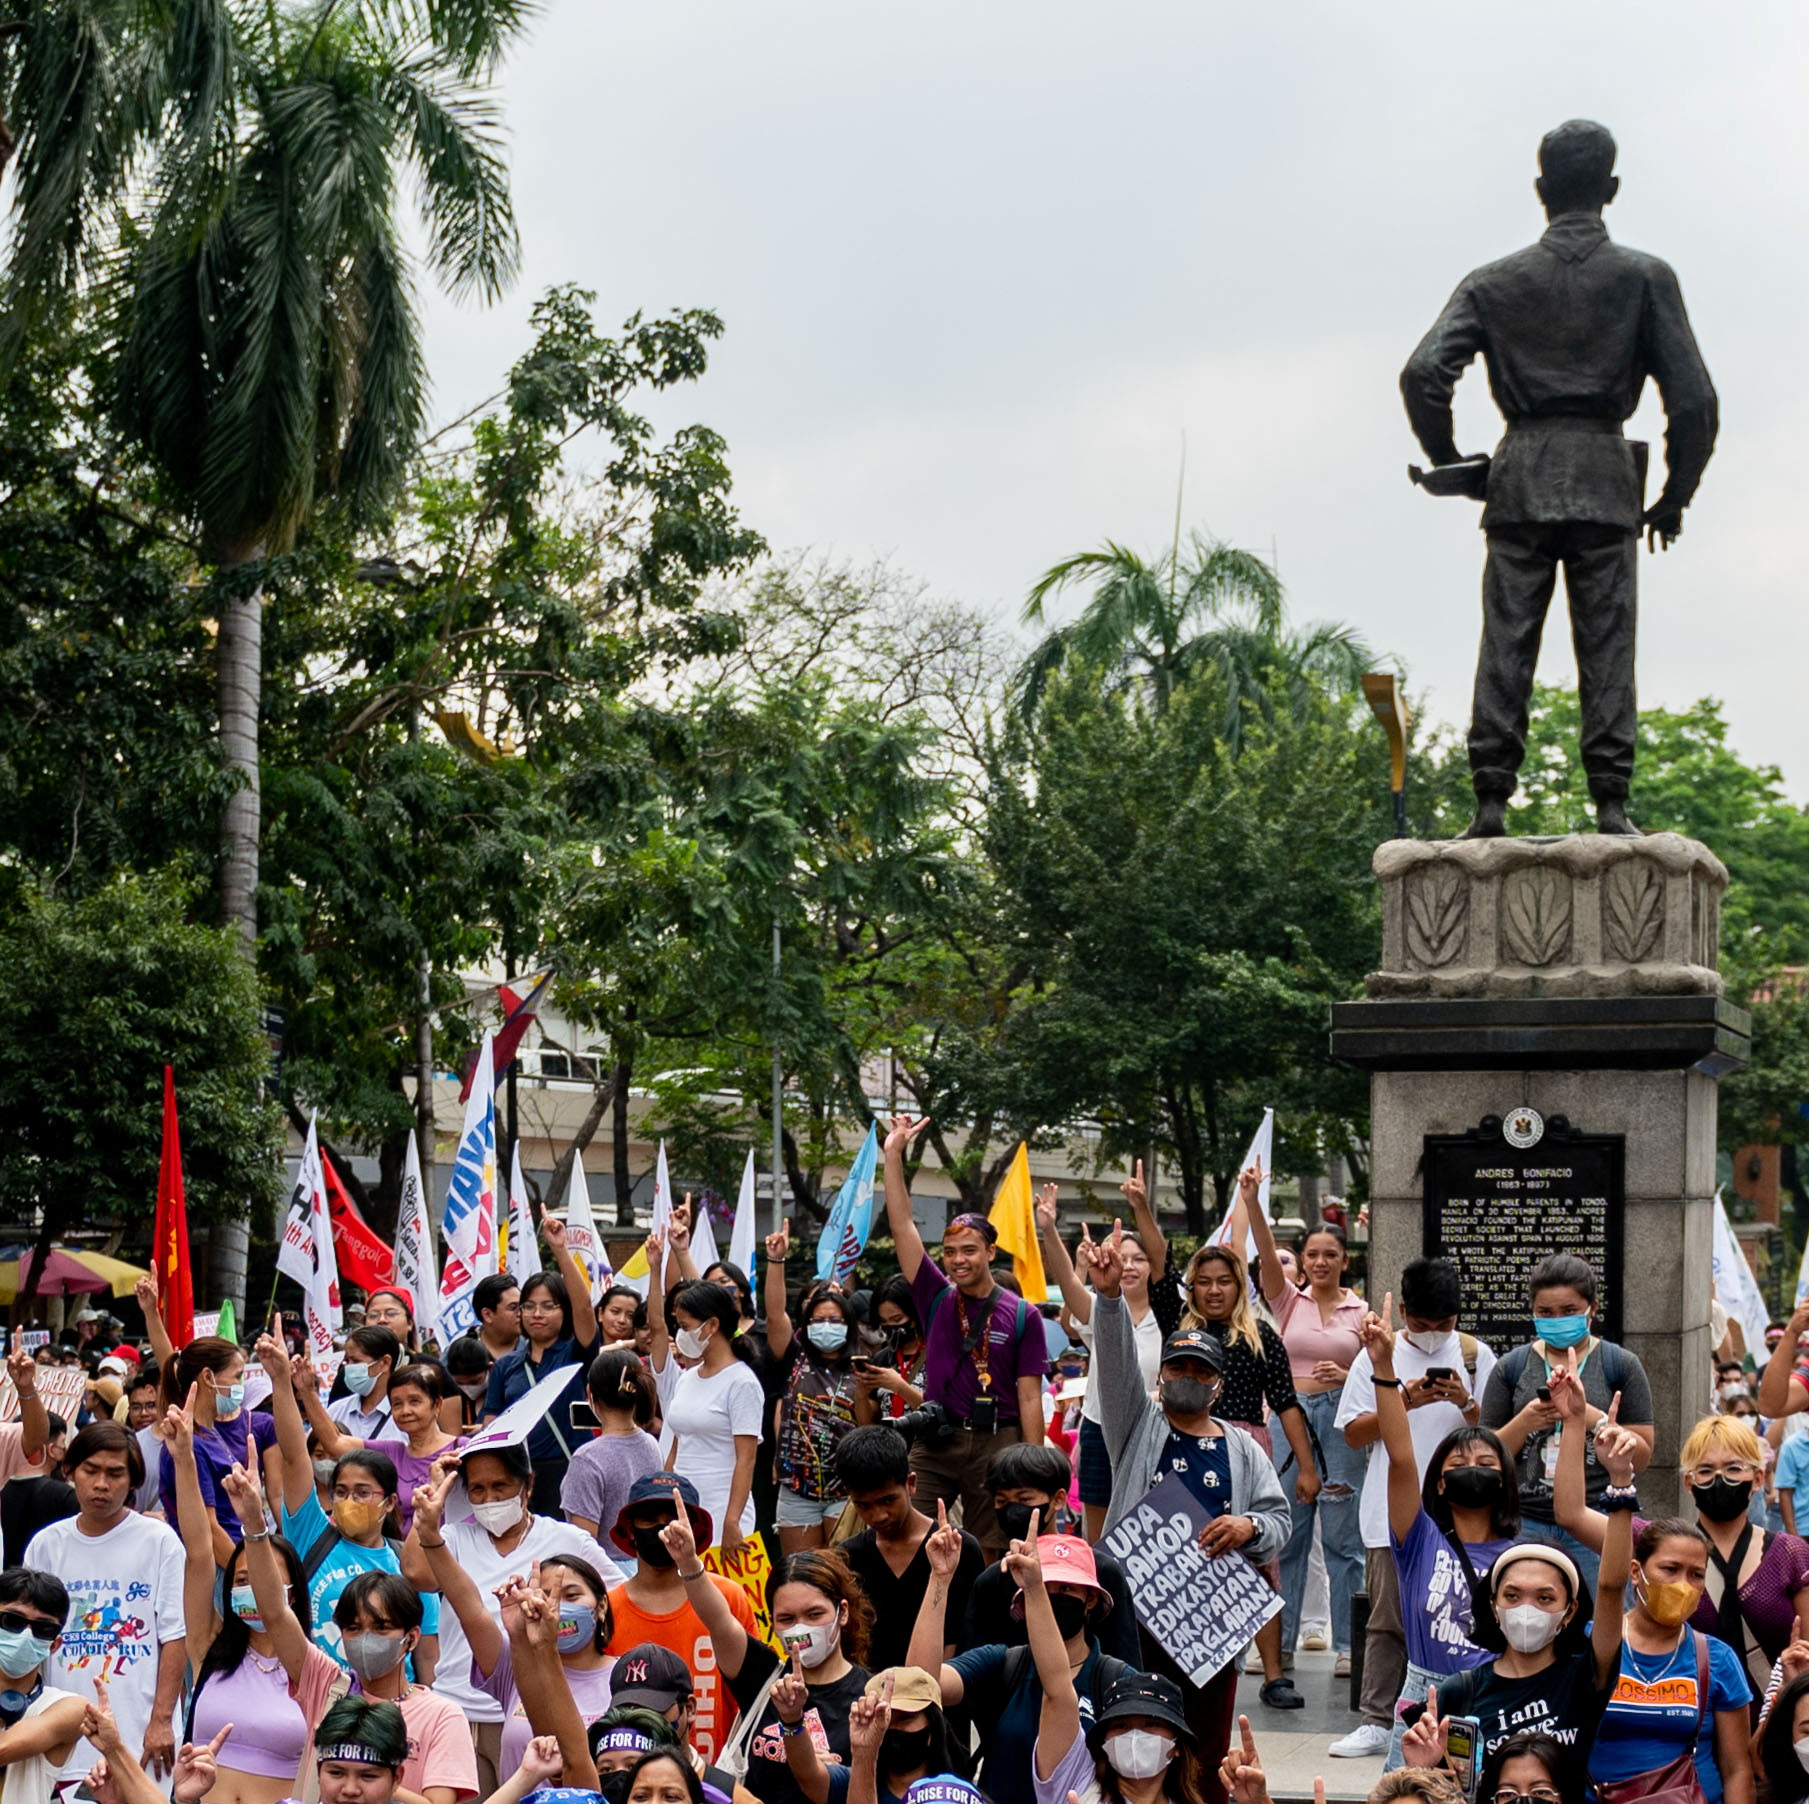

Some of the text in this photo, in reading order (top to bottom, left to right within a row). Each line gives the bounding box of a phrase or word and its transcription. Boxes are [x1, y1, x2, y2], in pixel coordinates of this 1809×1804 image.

[1474, 1168, 1573, 1178] ANDRES BONIFACIO
[1105, 1503, 1164, 1559] UPA
[1116, 1511, 1193, 1595] AHOD
[1133, 1539, 1212, 1618] TRABAH
[1146, 1549, 1244, 1641] EDUKASYON
[309, 1566, 347, 1625] JUSTICE FOR
[1161, 1562, 1258, 1657] KARAPATAN
[81, 1631, 115, 1642] College
[1176, 1576, 1276, 1674] IPAGLABAN!
[118, 1643, 152, 1657] RUN
[1616, 1680, 1690, 1701] OSSIMO
[1498, 1698, 1551, 1731] i am
[339, 1743, 361, 1760] FOR
[610, 1732, 632, 1748] FOR
[917, 1785, 944, 1804] RISE
